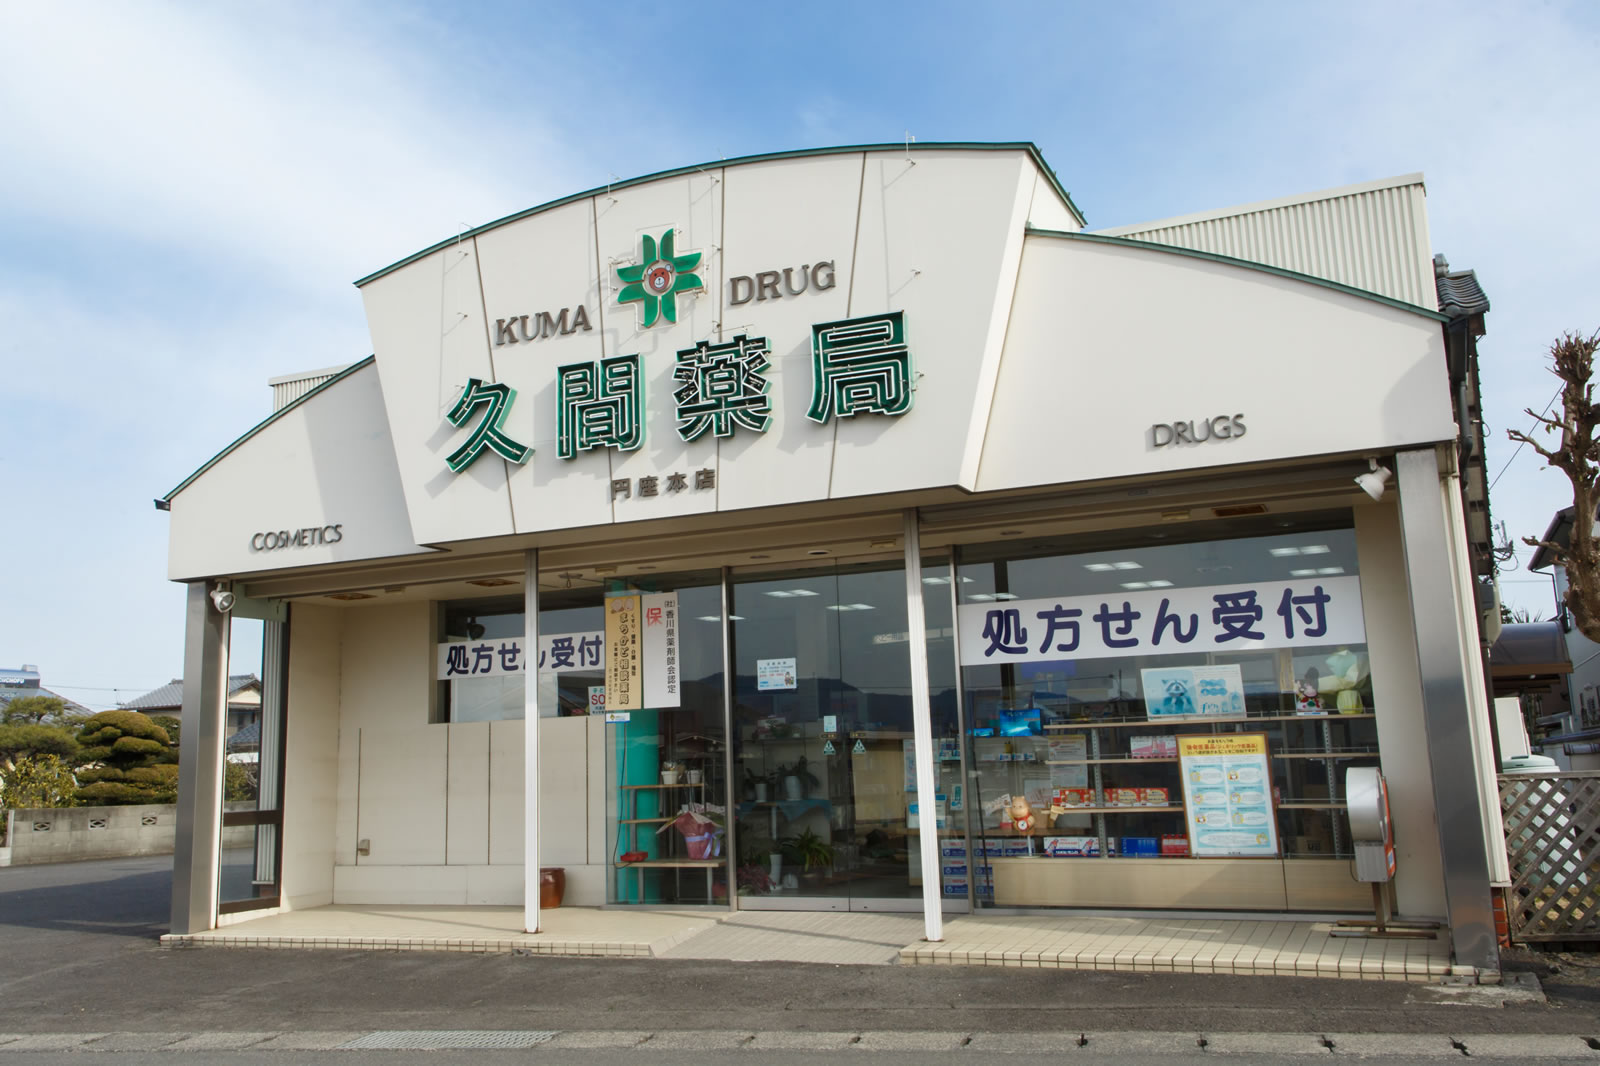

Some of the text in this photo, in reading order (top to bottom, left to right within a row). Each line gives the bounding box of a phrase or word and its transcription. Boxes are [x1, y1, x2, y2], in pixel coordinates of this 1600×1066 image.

[495, 260, 837, 346] KUMA DRUG
[446, 309, 917, 474] 久間薬局
[1152, 413, 1247, 447] DRUGS
[610, 467, 717, 502] 円座本店
[252, 524, 344, 552] COSMETICS
[646, 607, 662, 626] 保
[981, 584, 1332, 659] 処方せん受付
